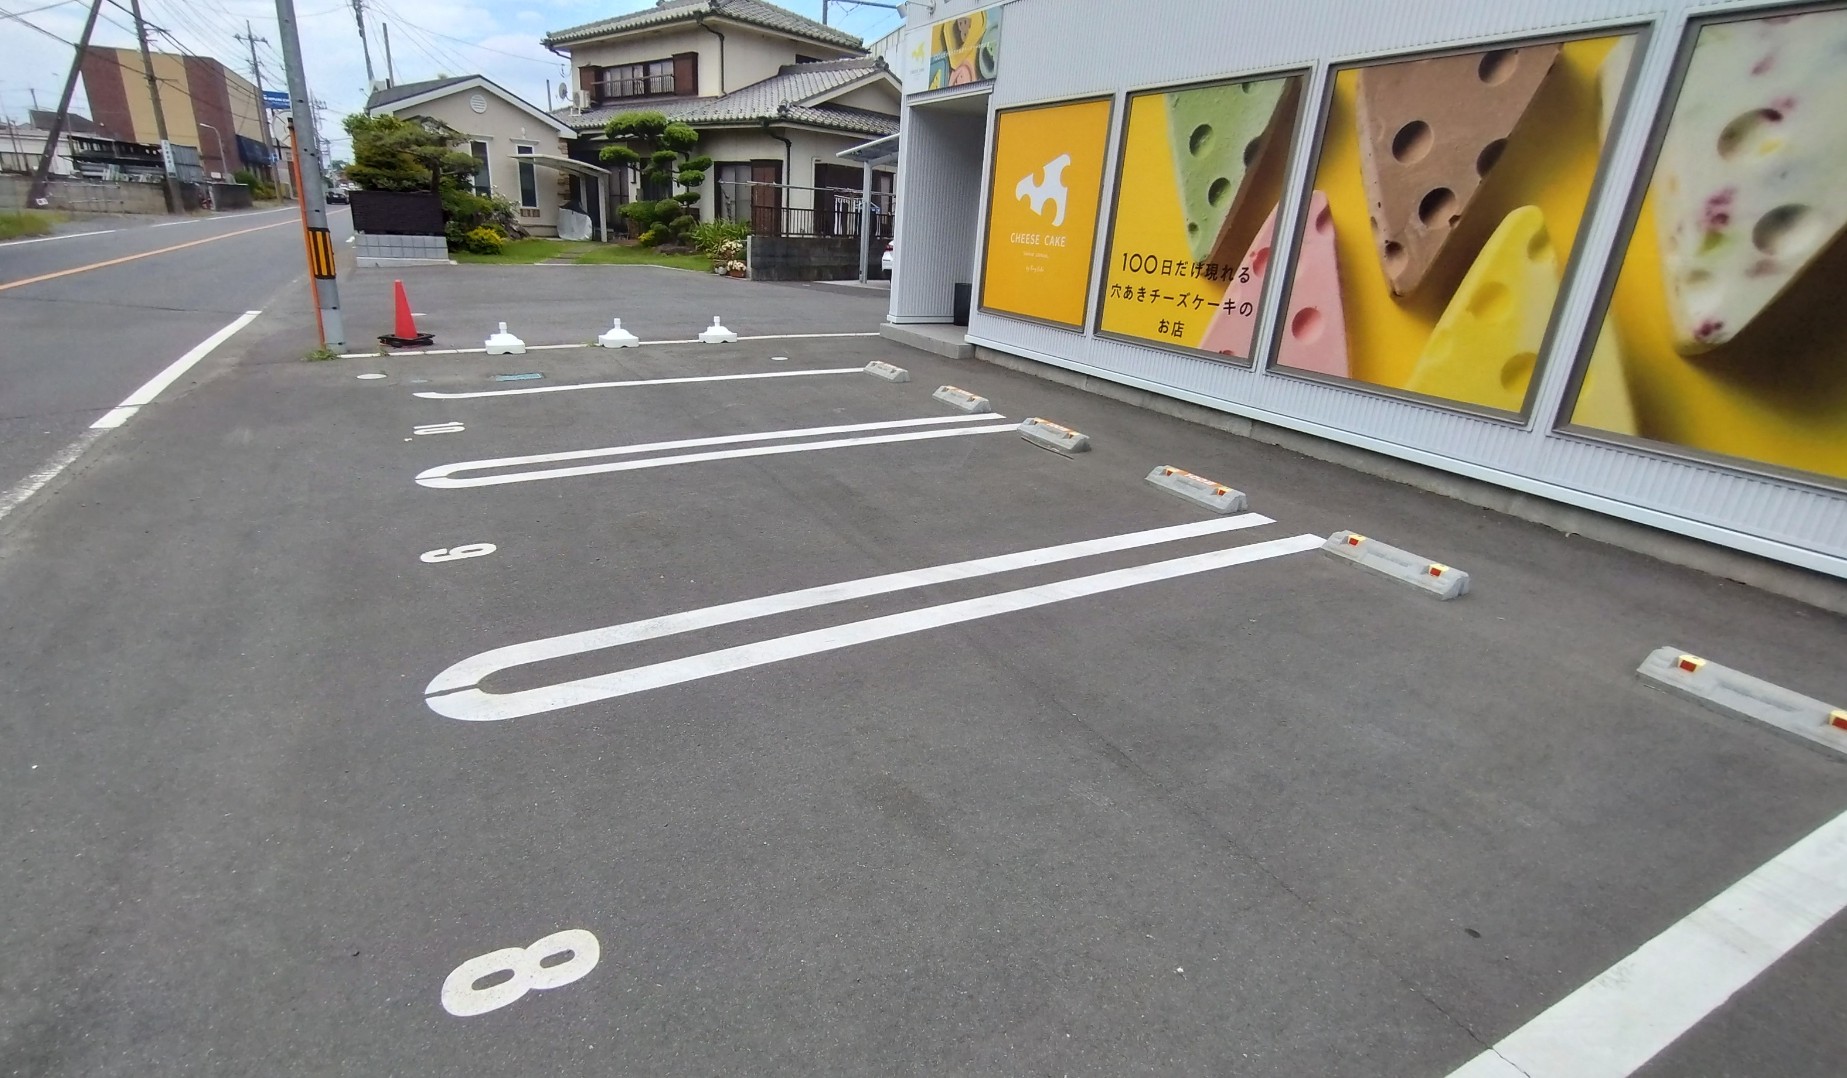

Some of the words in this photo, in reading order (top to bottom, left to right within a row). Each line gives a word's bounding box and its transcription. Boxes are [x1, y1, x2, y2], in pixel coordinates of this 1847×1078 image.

[1010, 232, 1040, 245] CHEESE
[1044, 235, 1066, 247] CAKE
[1122, 252, 1251, 284] 100日だけ現れる
[1110, 283, 1253, 317] 穴あきチーズケーキの
[1158, 318, 1185, 338] お店
[441, 929, 600, 1017] 8
